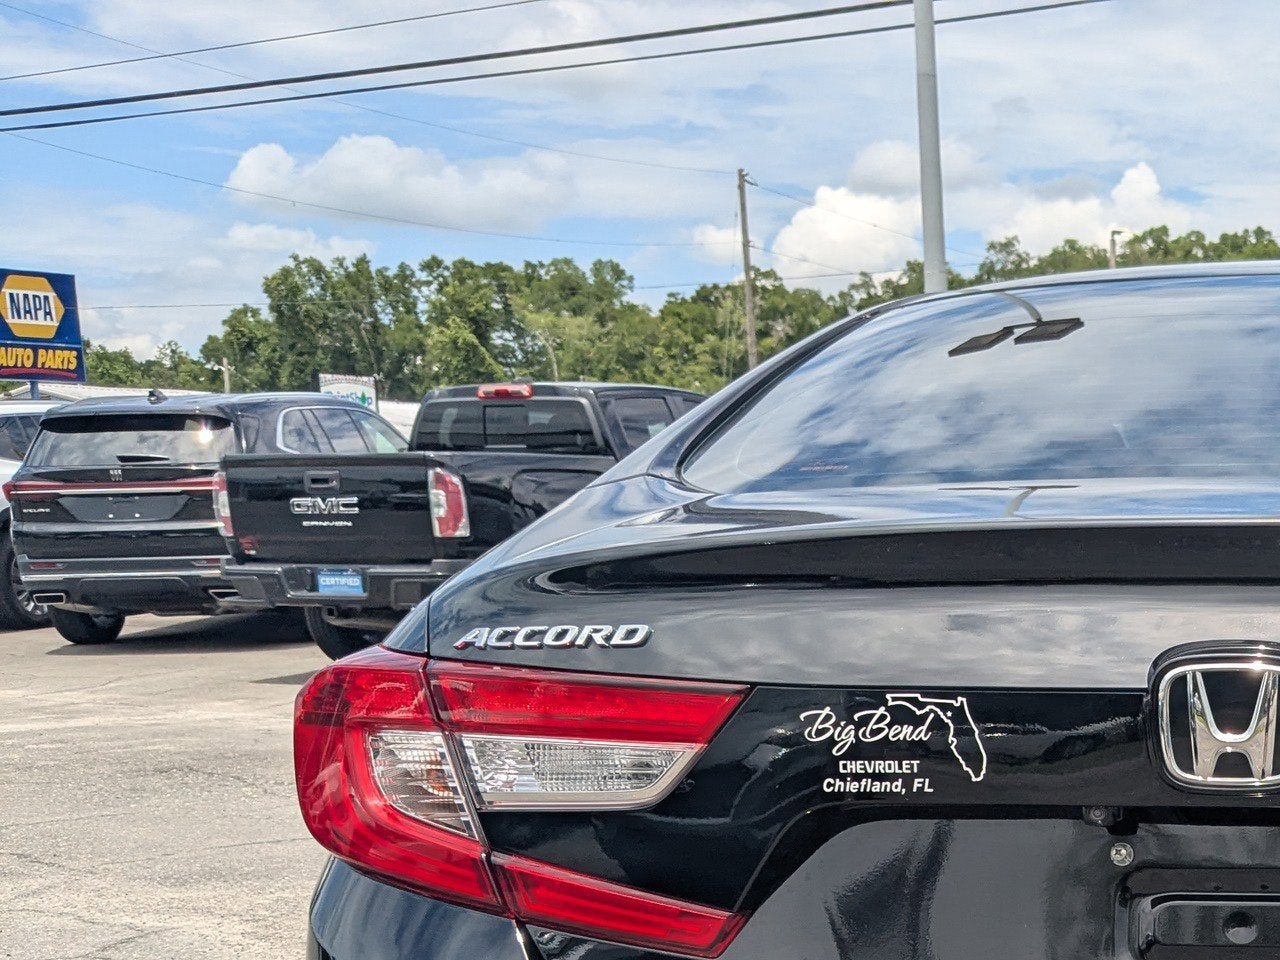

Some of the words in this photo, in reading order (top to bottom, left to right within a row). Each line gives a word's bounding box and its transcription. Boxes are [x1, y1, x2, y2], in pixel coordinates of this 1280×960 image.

[8, 292, 54, 322] NAPA
[0, 346, 34, 368] AUTO
[37, 348, 78, 370] PARTS
[289, 497, 360, 515] GMC
[320, 577, 361, 586] CERTIFIED
[453, 624, 652, 650] ACCORD
[799, 706, 856, 756] Big
[853, 706, 935, 743] Bend
[838, 760, 920, 774] CHEVROLET
[822, 777, 906, 795] Chiefland,
[912, 778, 934, 793] FL
